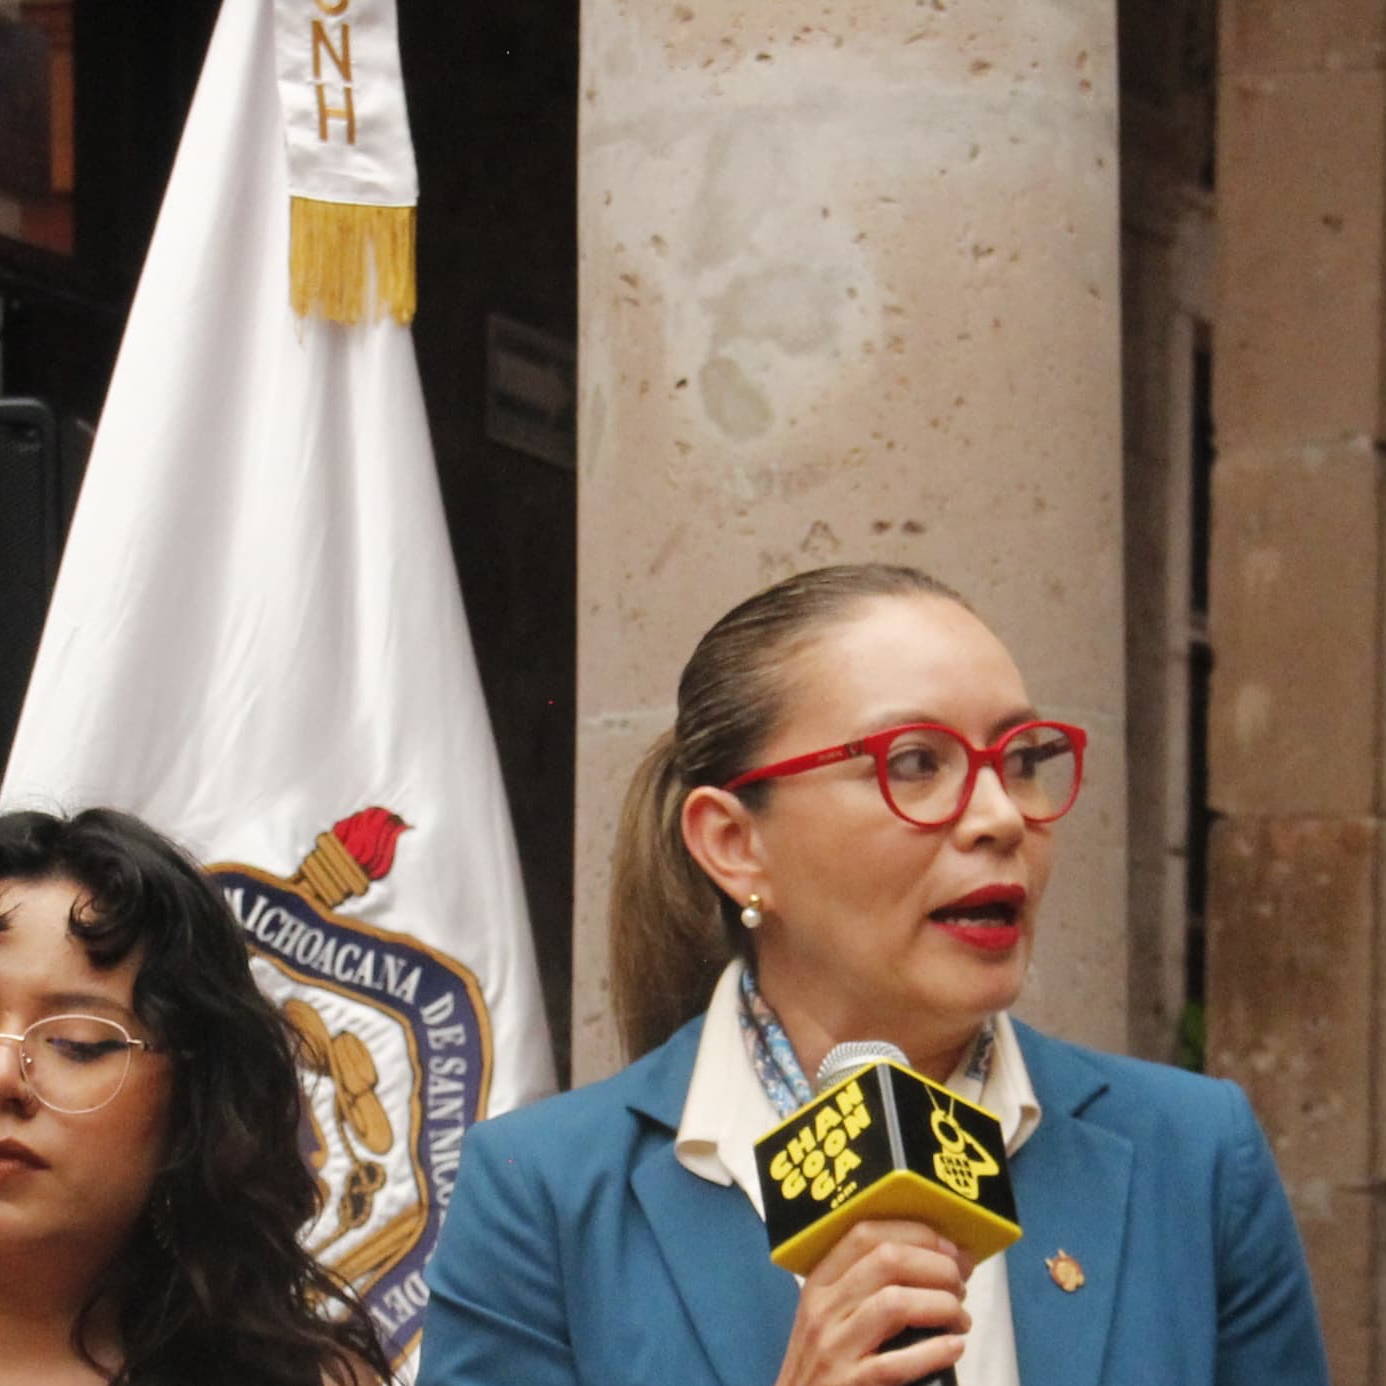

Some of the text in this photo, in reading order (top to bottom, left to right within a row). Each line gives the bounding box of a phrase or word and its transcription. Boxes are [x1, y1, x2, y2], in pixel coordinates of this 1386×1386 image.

[311, 0, 356, 145] NH
[420, 992, 466, 1050] DE
[428, 1056, 467, 1127] SAN
[770, 1080, 865, 1180] CHAN
[781, 1104, 871, 1199] GOON
[811, 1149, 861, 1200] GA
